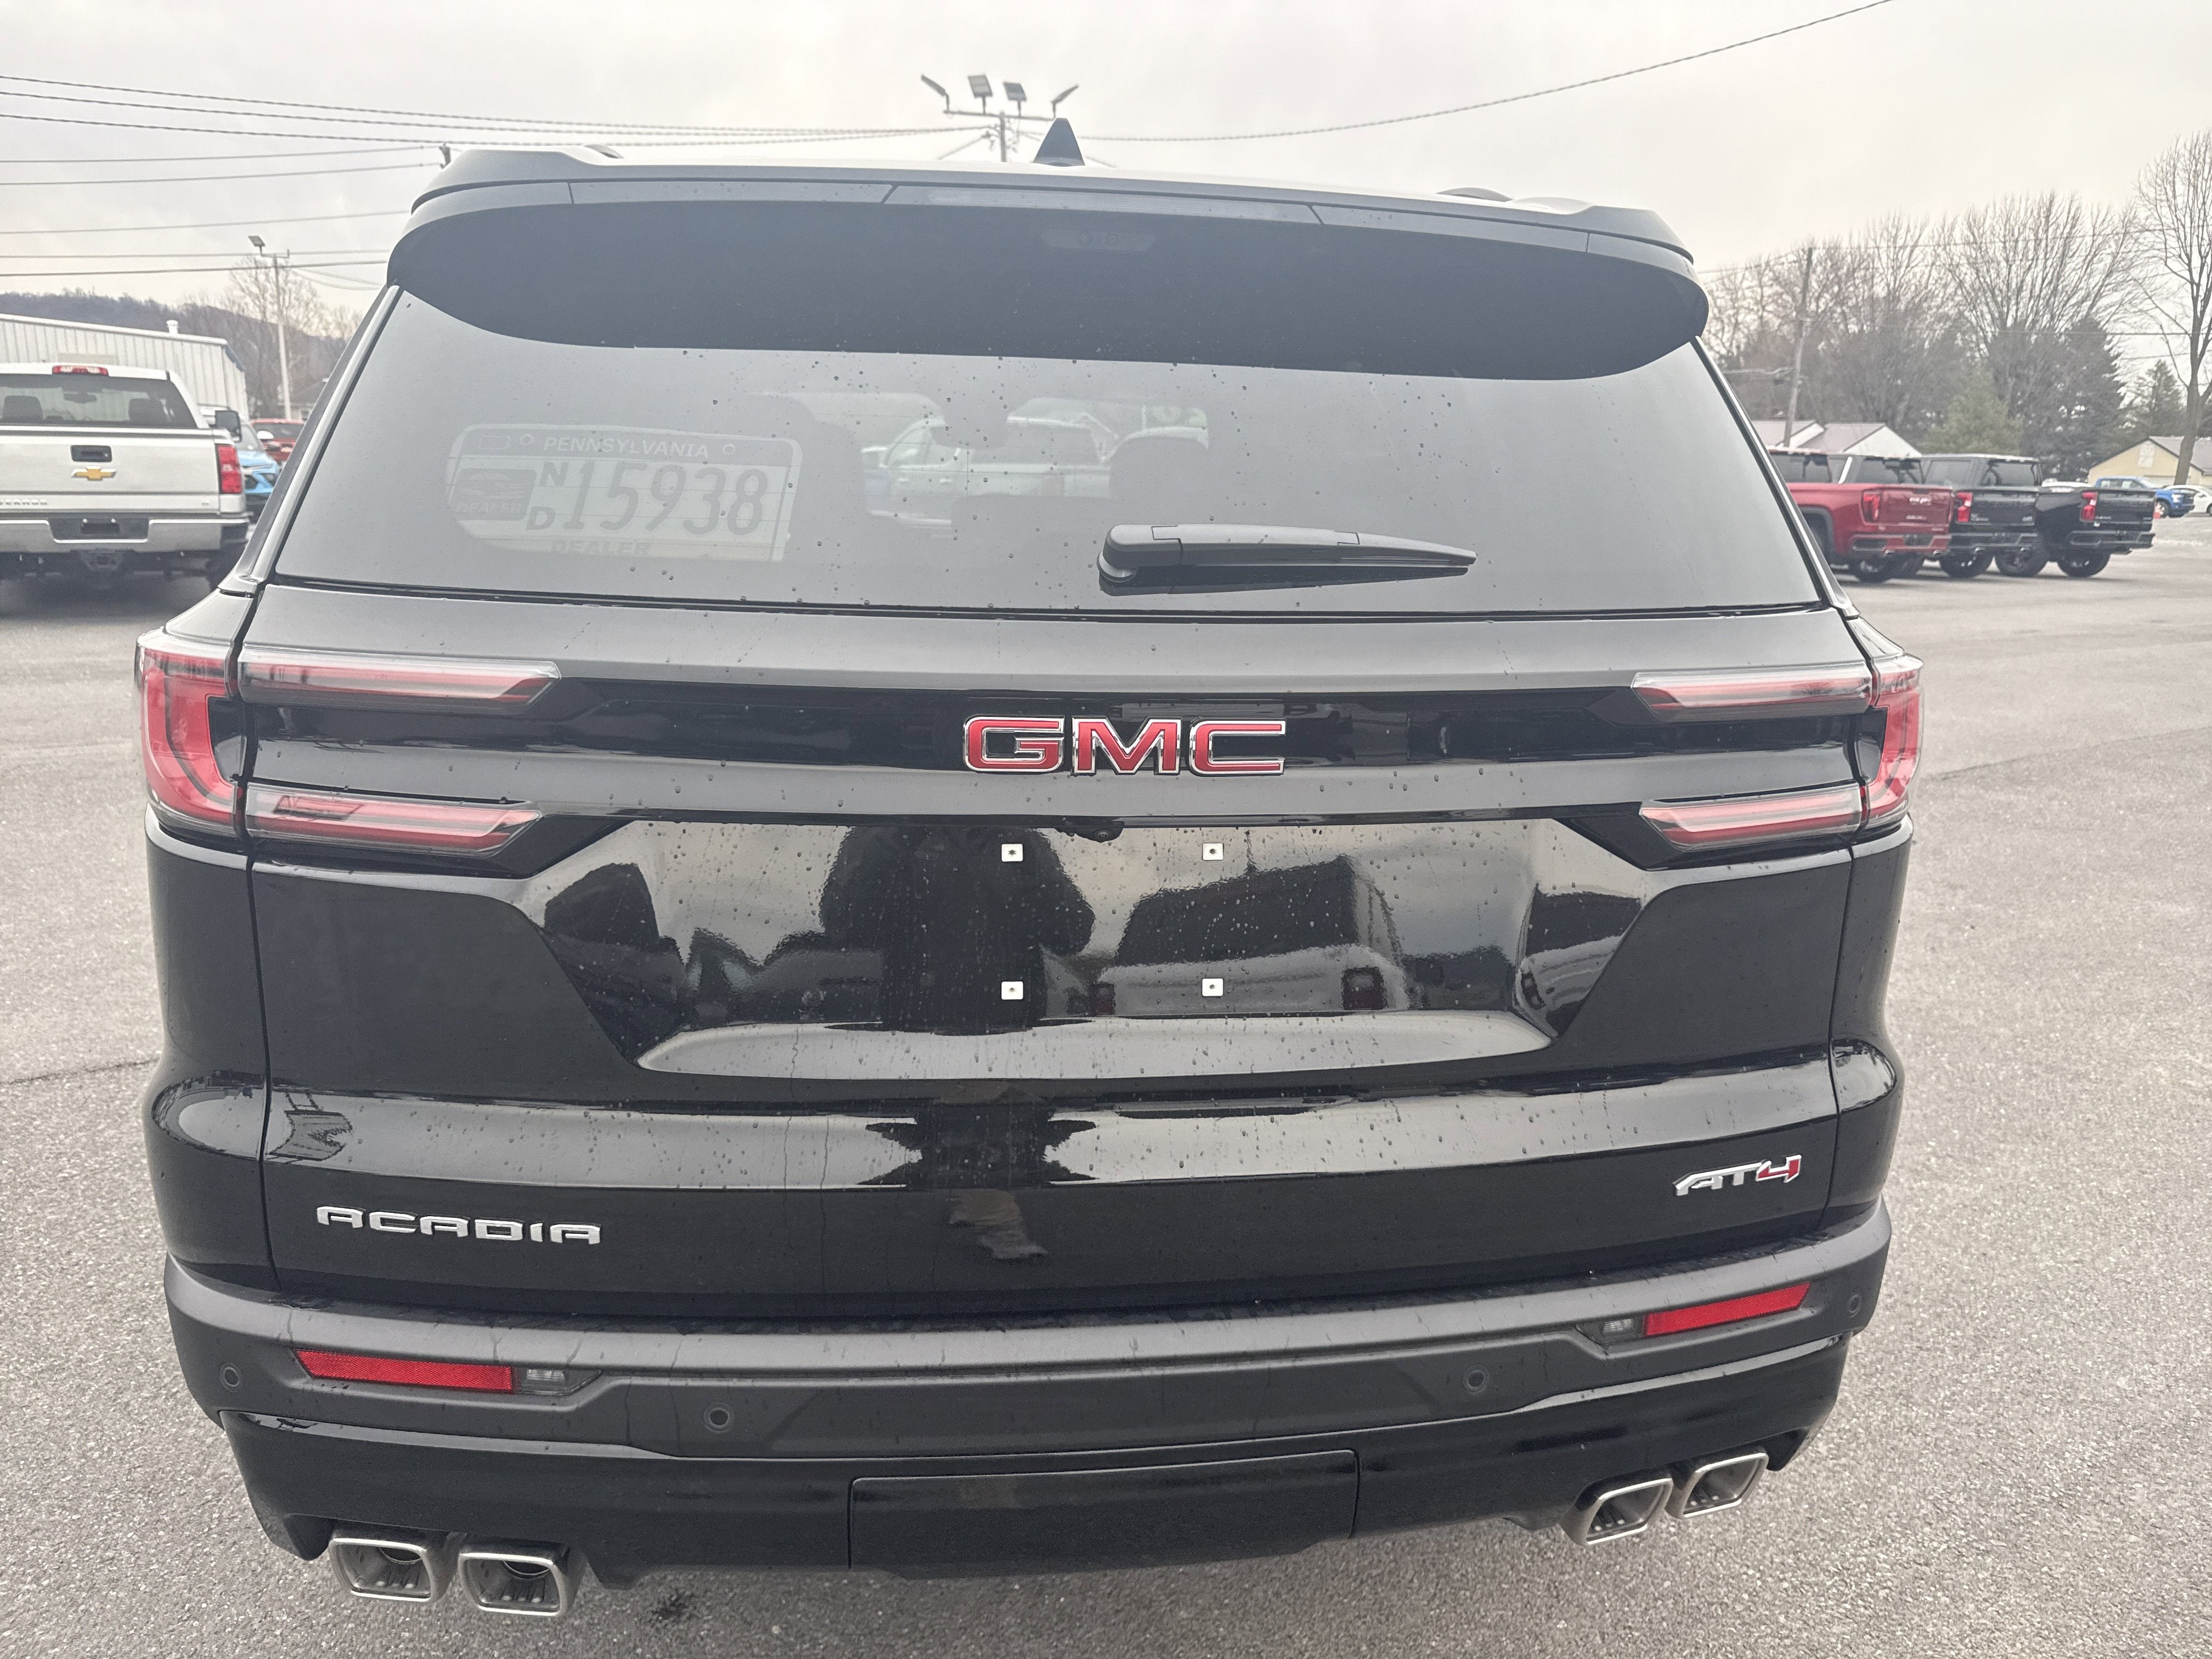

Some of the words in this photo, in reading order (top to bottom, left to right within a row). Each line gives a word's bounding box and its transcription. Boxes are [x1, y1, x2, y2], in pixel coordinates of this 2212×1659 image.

[543, 437, 709, 459] PENNSYLVANIA
[539, 461, 568, 487] N
[563, 461, 769, 535] 15938
[551, 540, 651, 558] DEALER
[963, 714, 1286, 776] GMC
[1675, 1155, 1802, 1197] AT4
[317, 1205, 601, 1245] ACADIA
